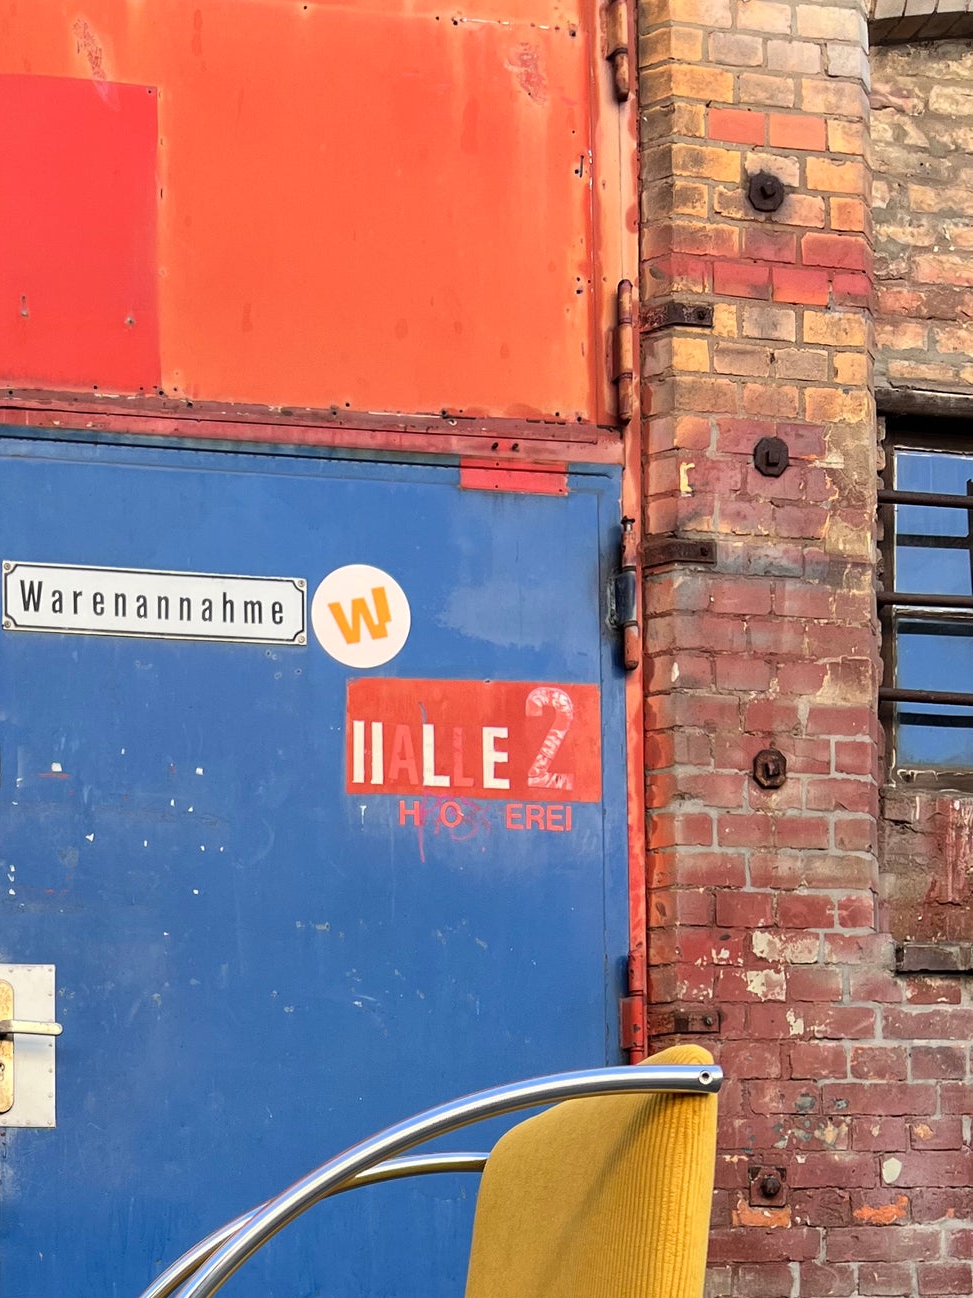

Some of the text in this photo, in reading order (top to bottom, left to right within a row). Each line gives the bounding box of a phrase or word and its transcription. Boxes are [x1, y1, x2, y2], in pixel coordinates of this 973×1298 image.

[19, 579, 284, 625] Warenannahme
[328, 586, 391, 644] W
[526, 687, 574, 790] 2
[506, 804, 572, 832] EREI
